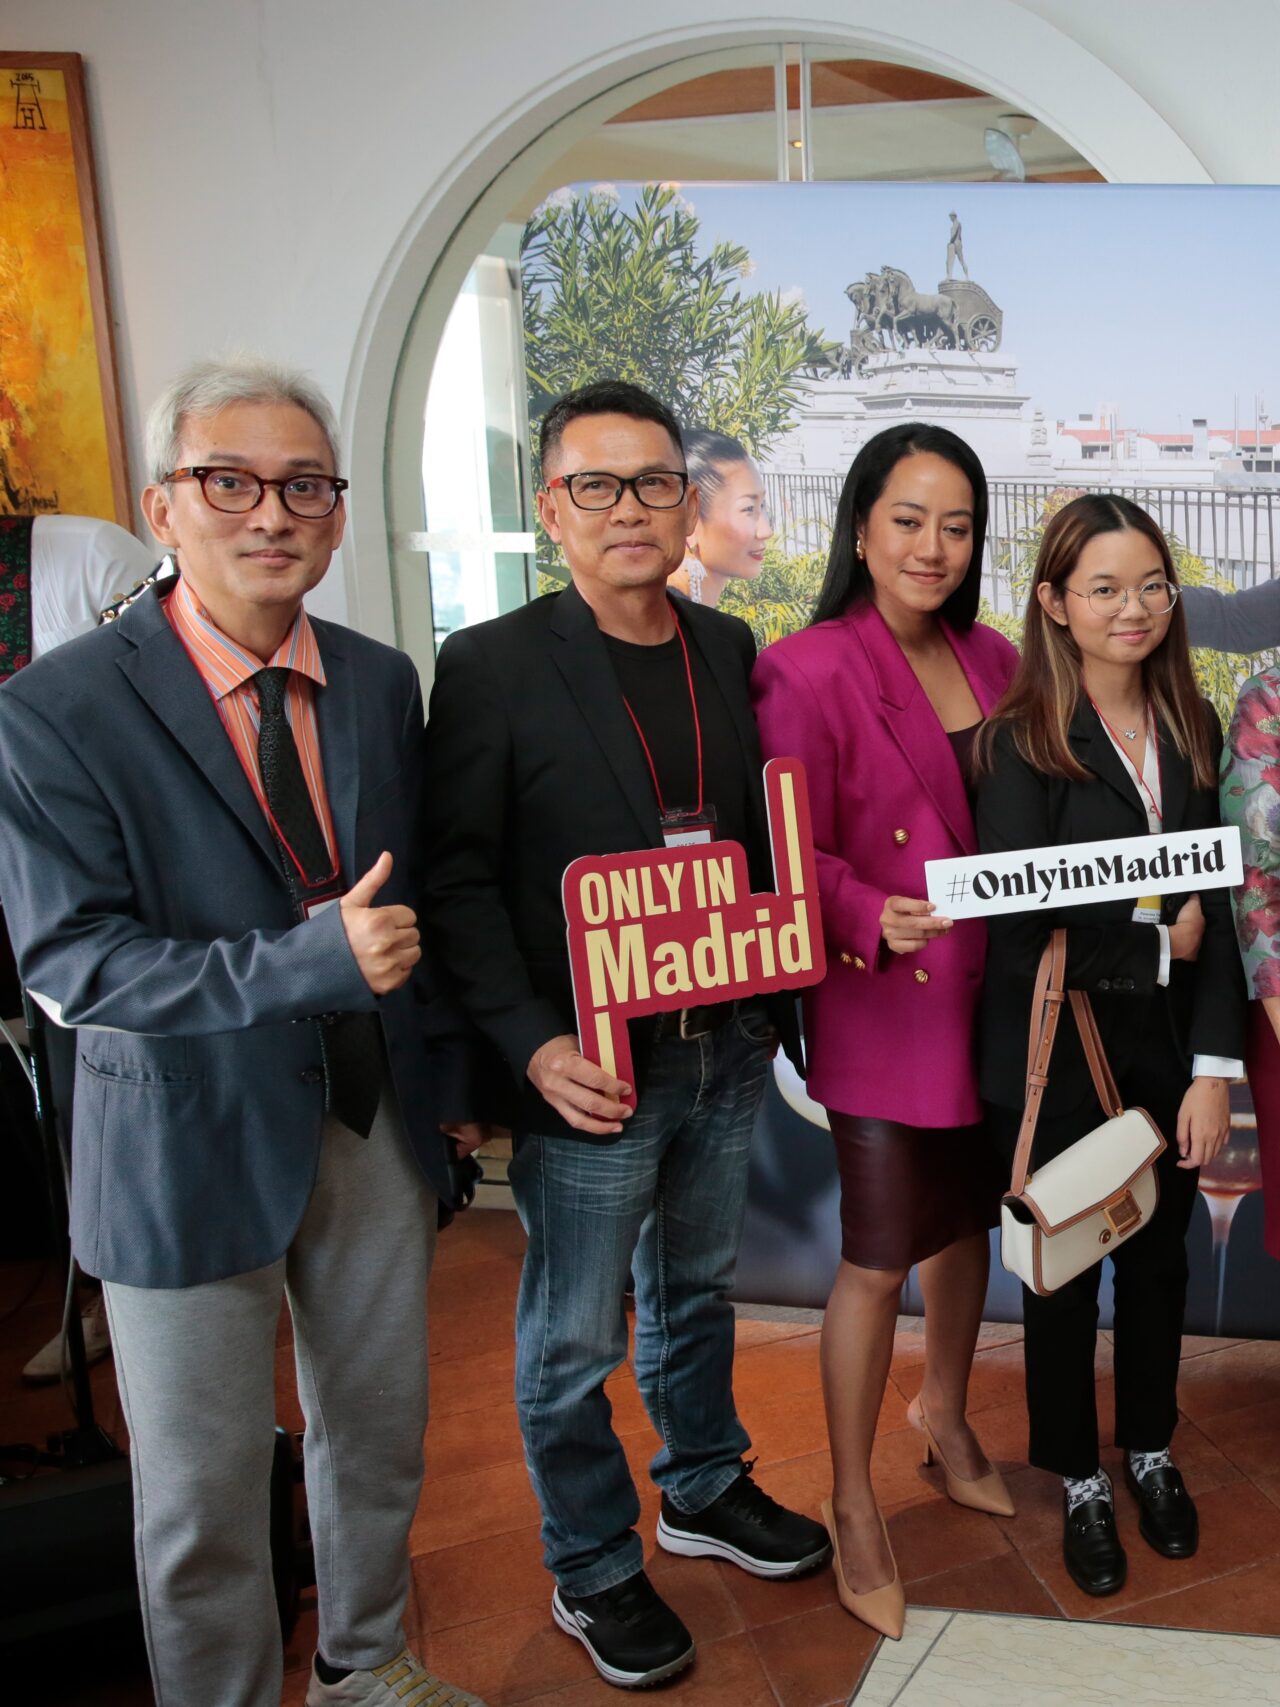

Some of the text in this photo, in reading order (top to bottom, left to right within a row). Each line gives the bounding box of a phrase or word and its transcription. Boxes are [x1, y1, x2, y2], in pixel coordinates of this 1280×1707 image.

[579, 856, 736, 925] ONLY IN
[945, 839, 1226, 903] #OnlyinMadrid
[585, 899, 813, 1008] Madrid
